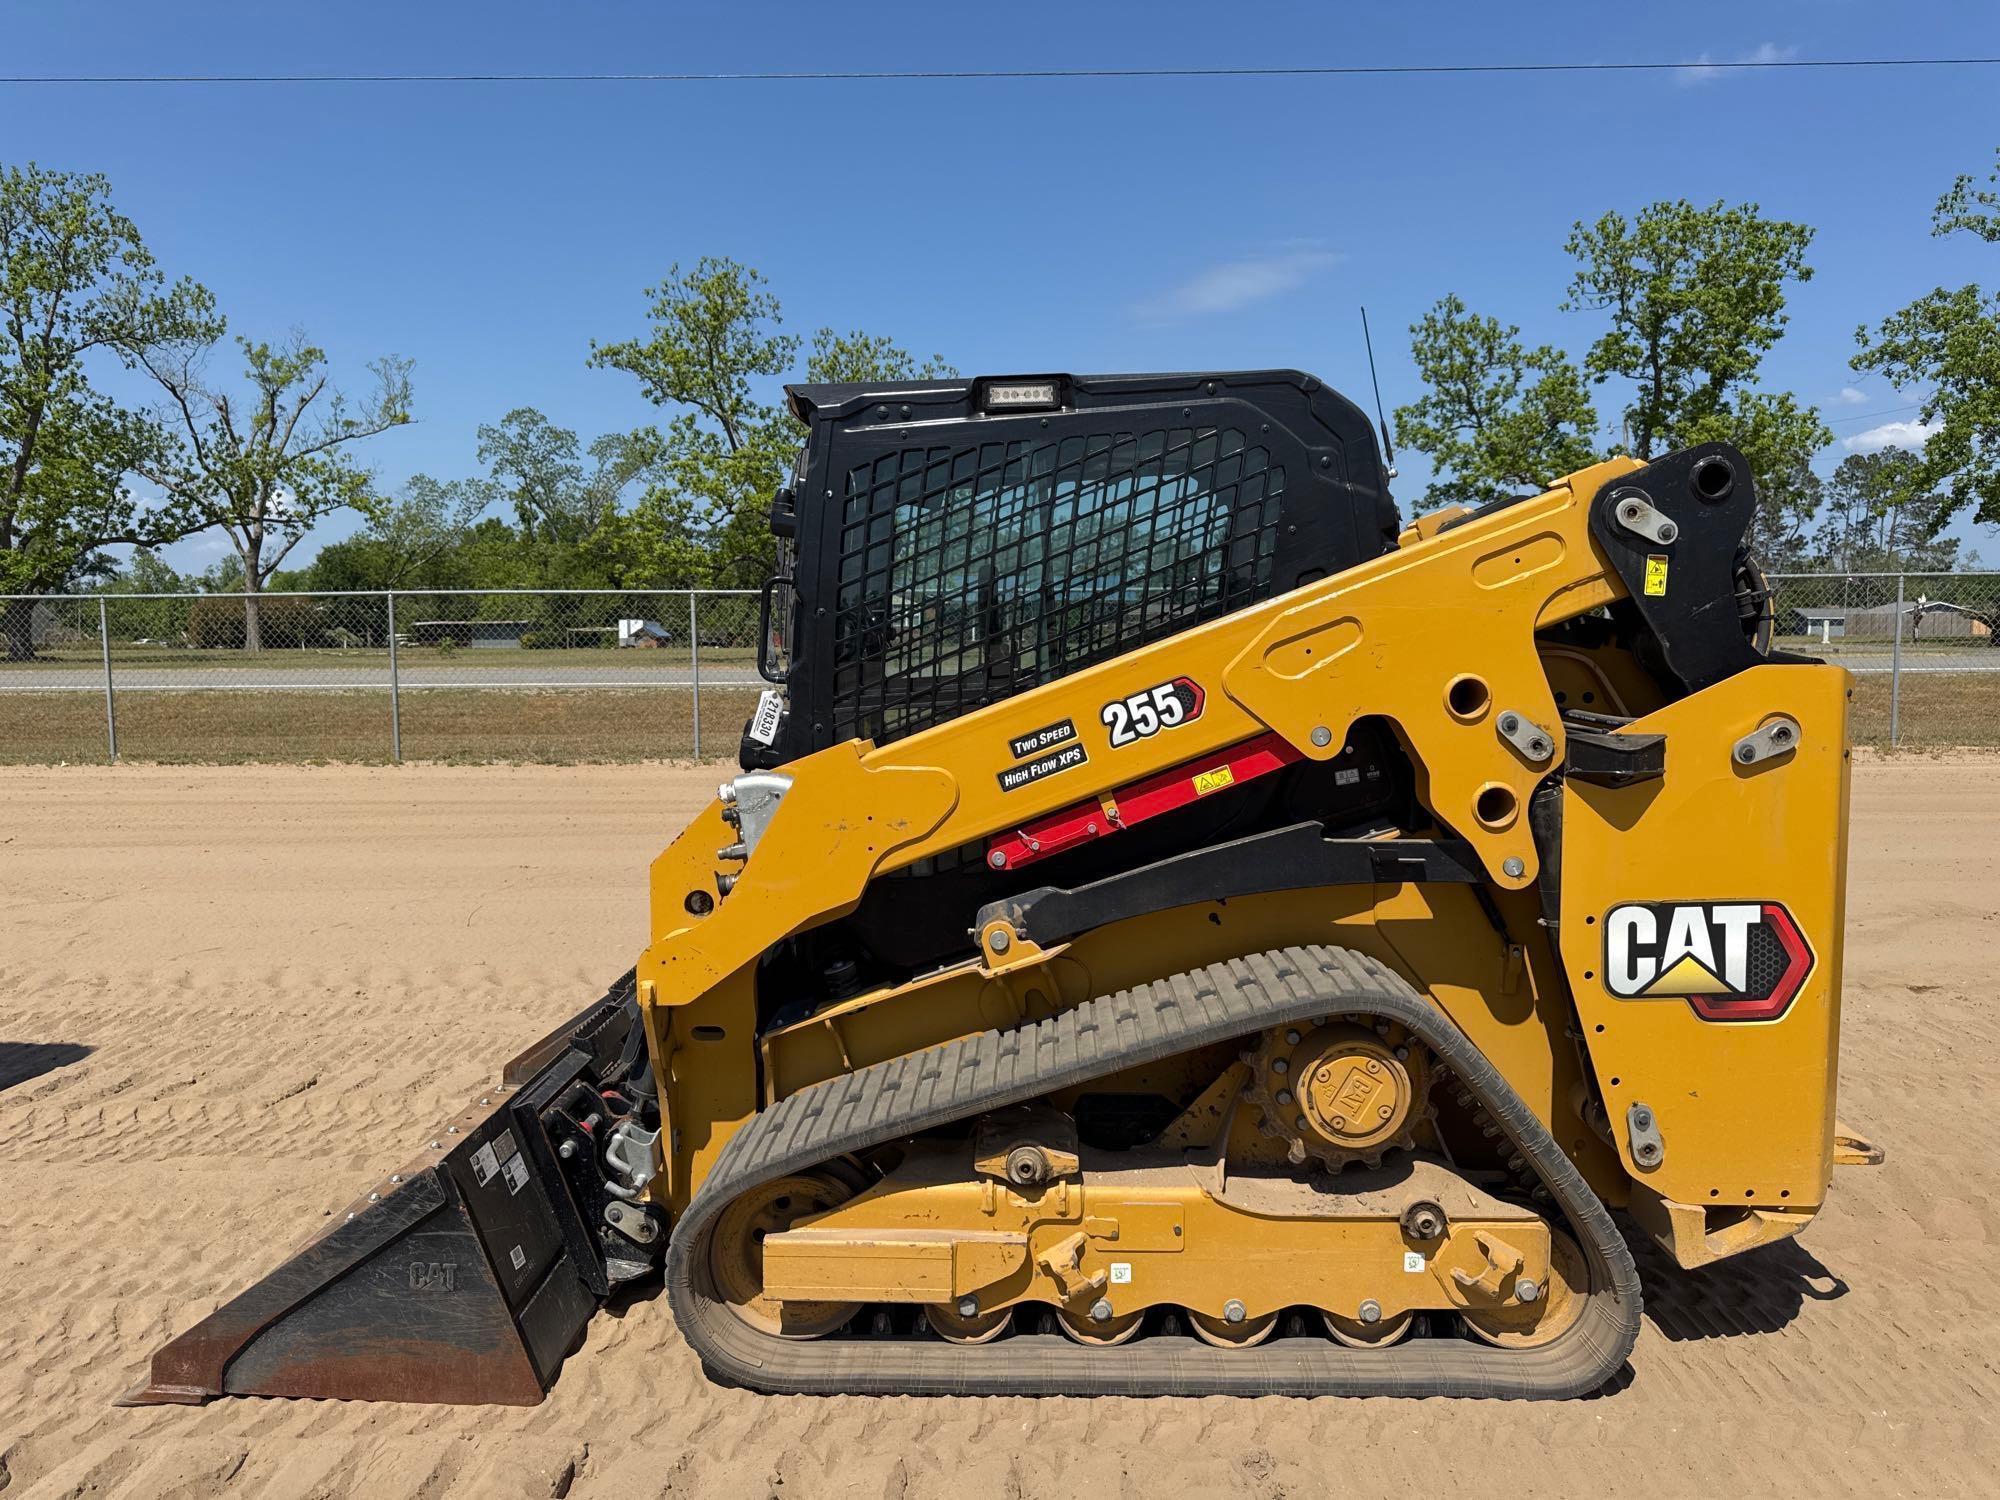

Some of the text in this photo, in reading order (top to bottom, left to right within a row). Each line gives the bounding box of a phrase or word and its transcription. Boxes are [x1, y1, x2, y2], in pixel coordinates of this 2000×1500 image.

[760, 700, 779, 737] 218330
[1103, 683, 1184, 745] 255
[1059, 748, 1081, 766] XPS
[1607, 904, 1761, 995] CAT
[1339, 1075, 1372, 1115] CAT
[409, 1261, 458, 1292] CAT
